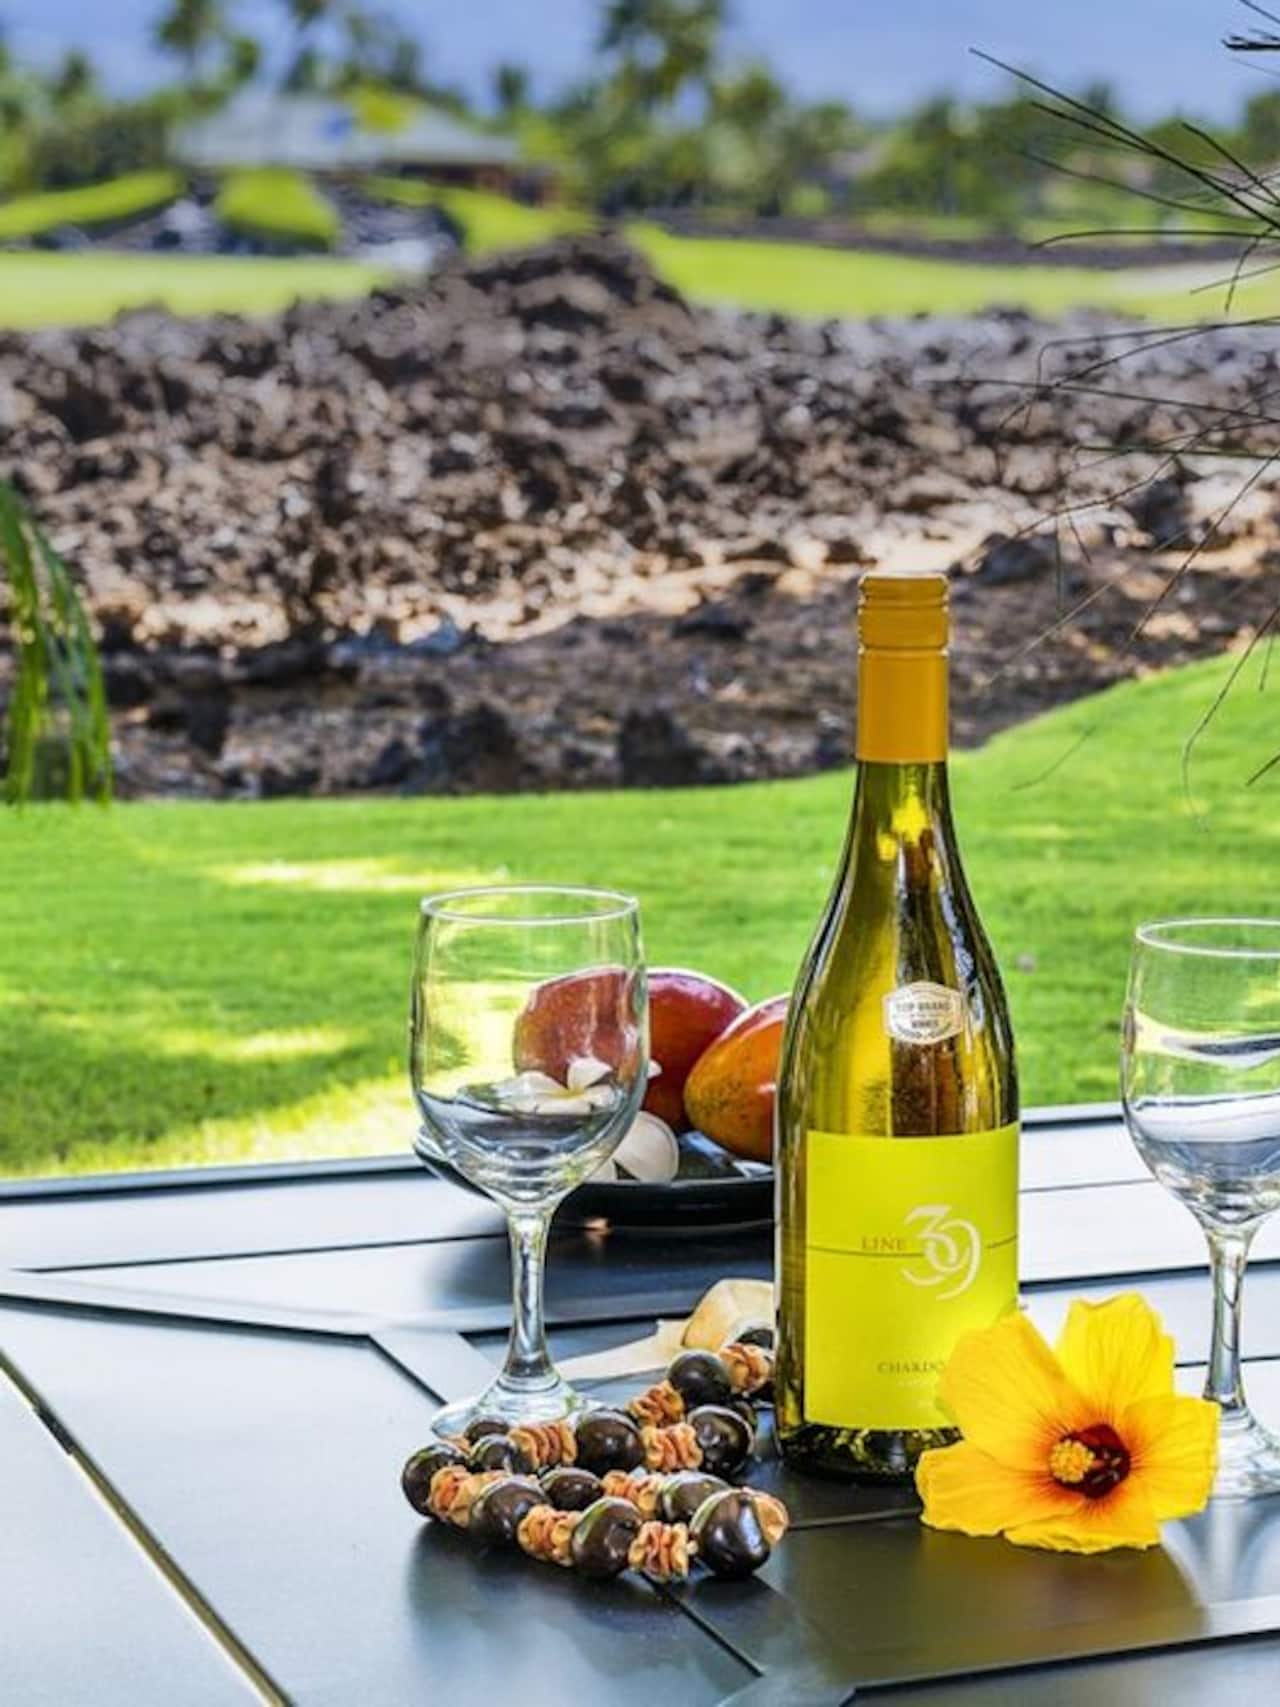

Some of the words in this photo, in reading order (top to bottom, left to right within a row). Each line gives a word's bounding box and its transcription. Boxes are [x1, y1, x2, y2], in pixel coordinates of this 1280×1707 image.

[861, 1236, 906, 1251] LINE
[900, 1203, 982, 1301] 39
[877, 1360, 946, 1375] CHARDO
